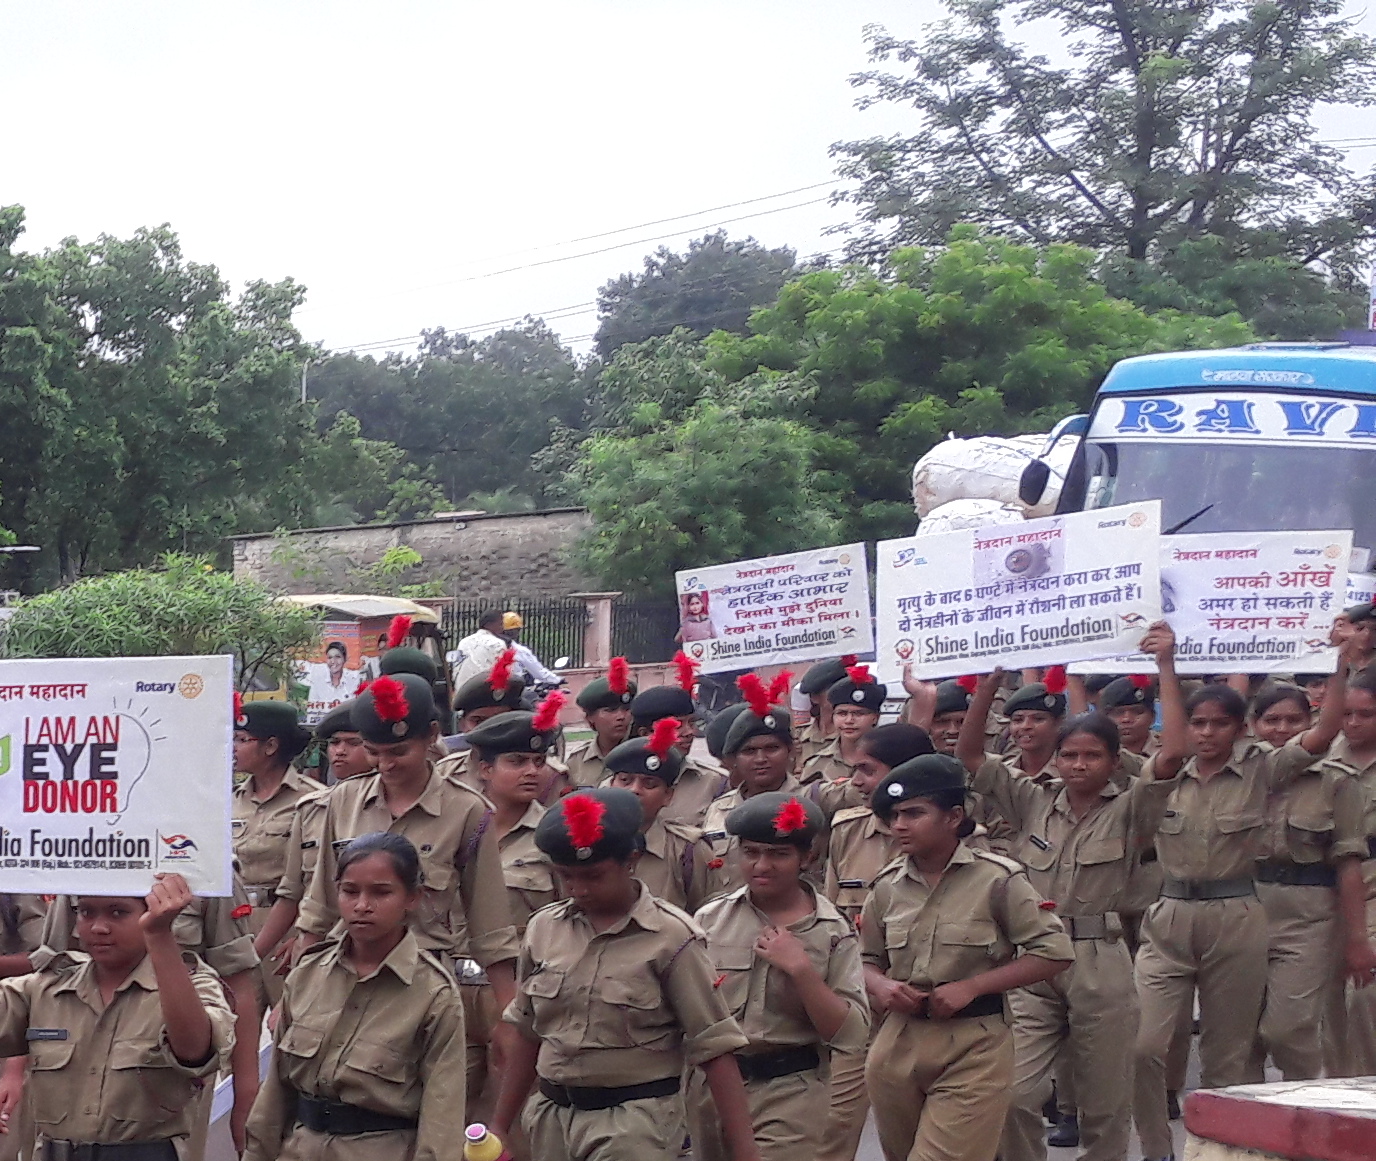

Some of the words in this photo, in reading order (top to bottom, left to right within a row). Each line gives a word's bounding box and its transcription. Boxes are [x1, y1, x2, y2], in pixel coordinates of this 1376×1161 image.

[973, 537, 1012, 551] नेत्रदान
[1017, 528, 1063, 544] महादान
[925, 591, 938, 605] के
[964, 590, 972, 601] 6
[1091, 566, 1111, 582] कर
[1214, 573, 1273, 590] आपकी
[962, 610, 973, 624] के
[711, 641, 741, 655] Shine
[745, 636, 771, 650] India
[775, 628, 835, 646] Foundation
[925, 635, 969, 657] Shine
[974, 627, 1014, 649] India
[1020, 616, 1112, 643] Foundation
[1208, 635, 1296, 655] Foundation
[28, 683, 88, 701] महादान
[136, 680, 176, 695] Rotary
[25, 716, 31, 745] I
[35, 716, 77, 745] AM
[87, 715, 121, 744] AN
[23, 744, 118, 780] EYE
[22, 780, 118, 814] DONOR
[30, 827, 150, 858] Foundation
